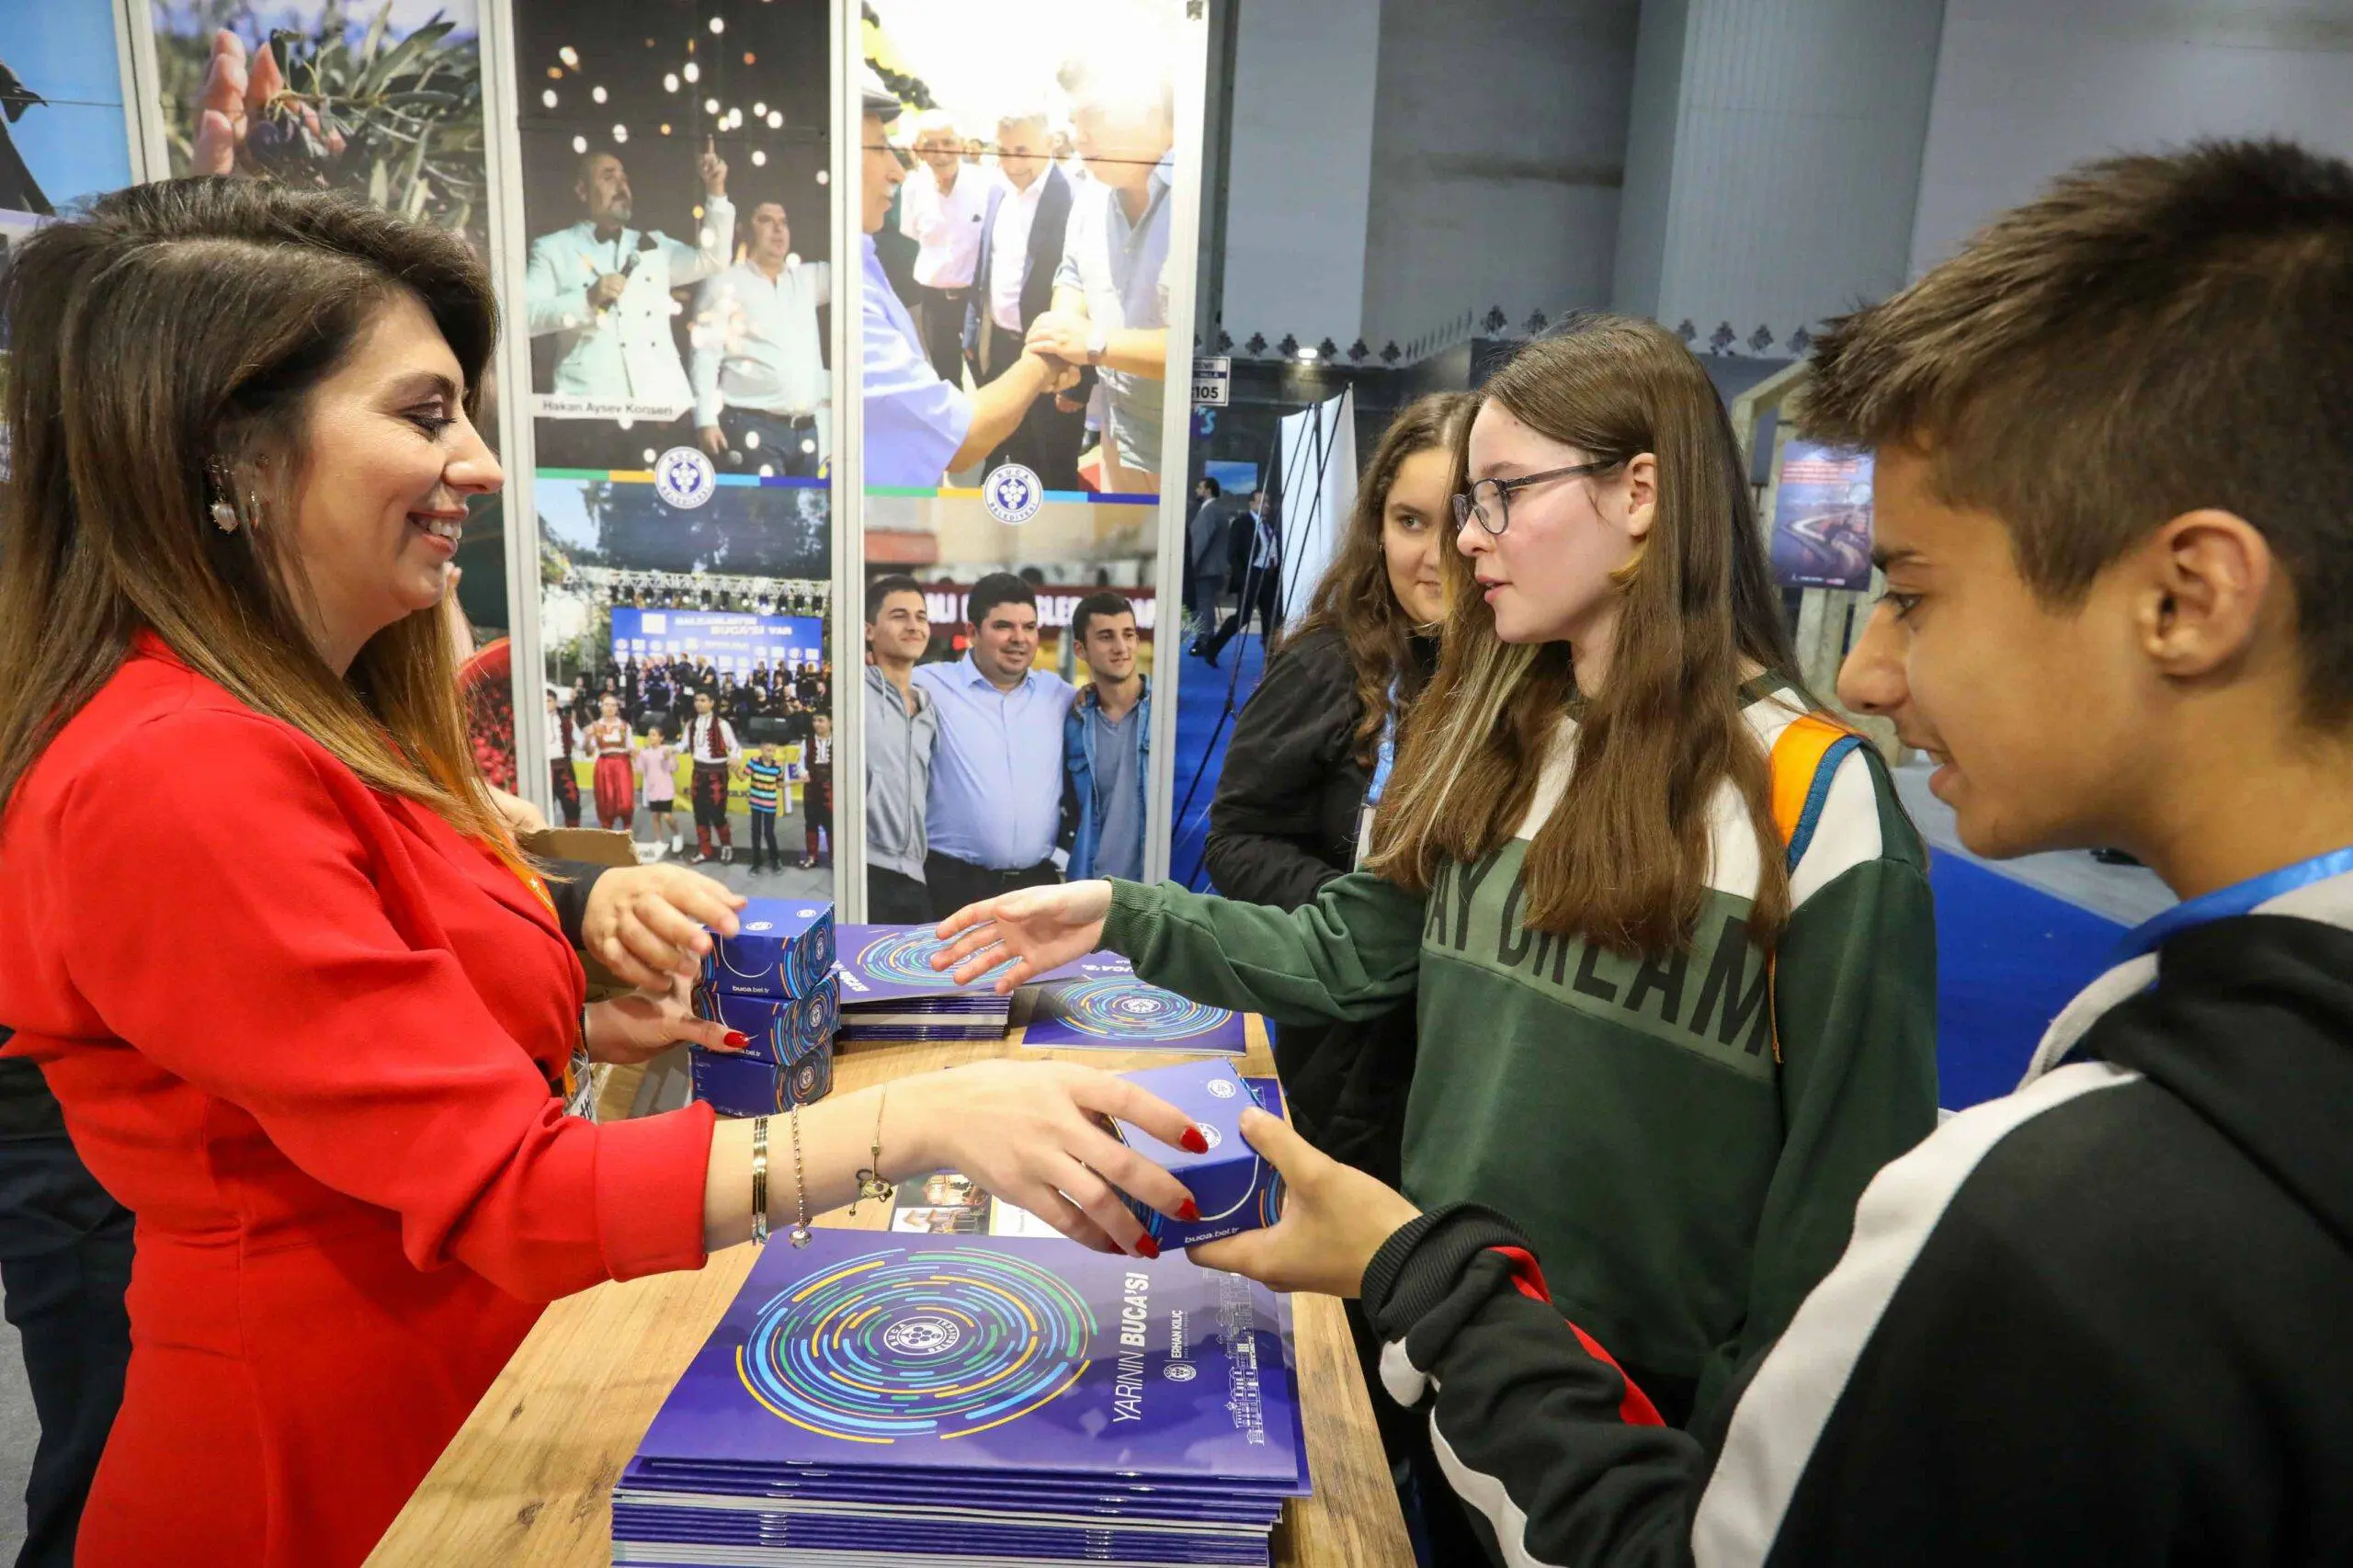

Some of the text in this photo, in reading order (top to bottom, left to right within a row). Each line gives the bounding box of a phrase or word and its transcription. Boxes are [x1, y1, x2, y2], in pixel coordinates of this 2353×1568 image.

[1192, 386, 1219, 399] 105
[542, 399, 673, 415] Hakan Aysev Konseri
[732, 984, 770, 994] buca.bel.tr
[1184, 1227, 1240, 1244] buca.bel.tr
[1170, 1310, 1184, 1358] ERHAN KILIÇ
[1112, 1271, 1150, 1423] YARININ BUCA'SI
